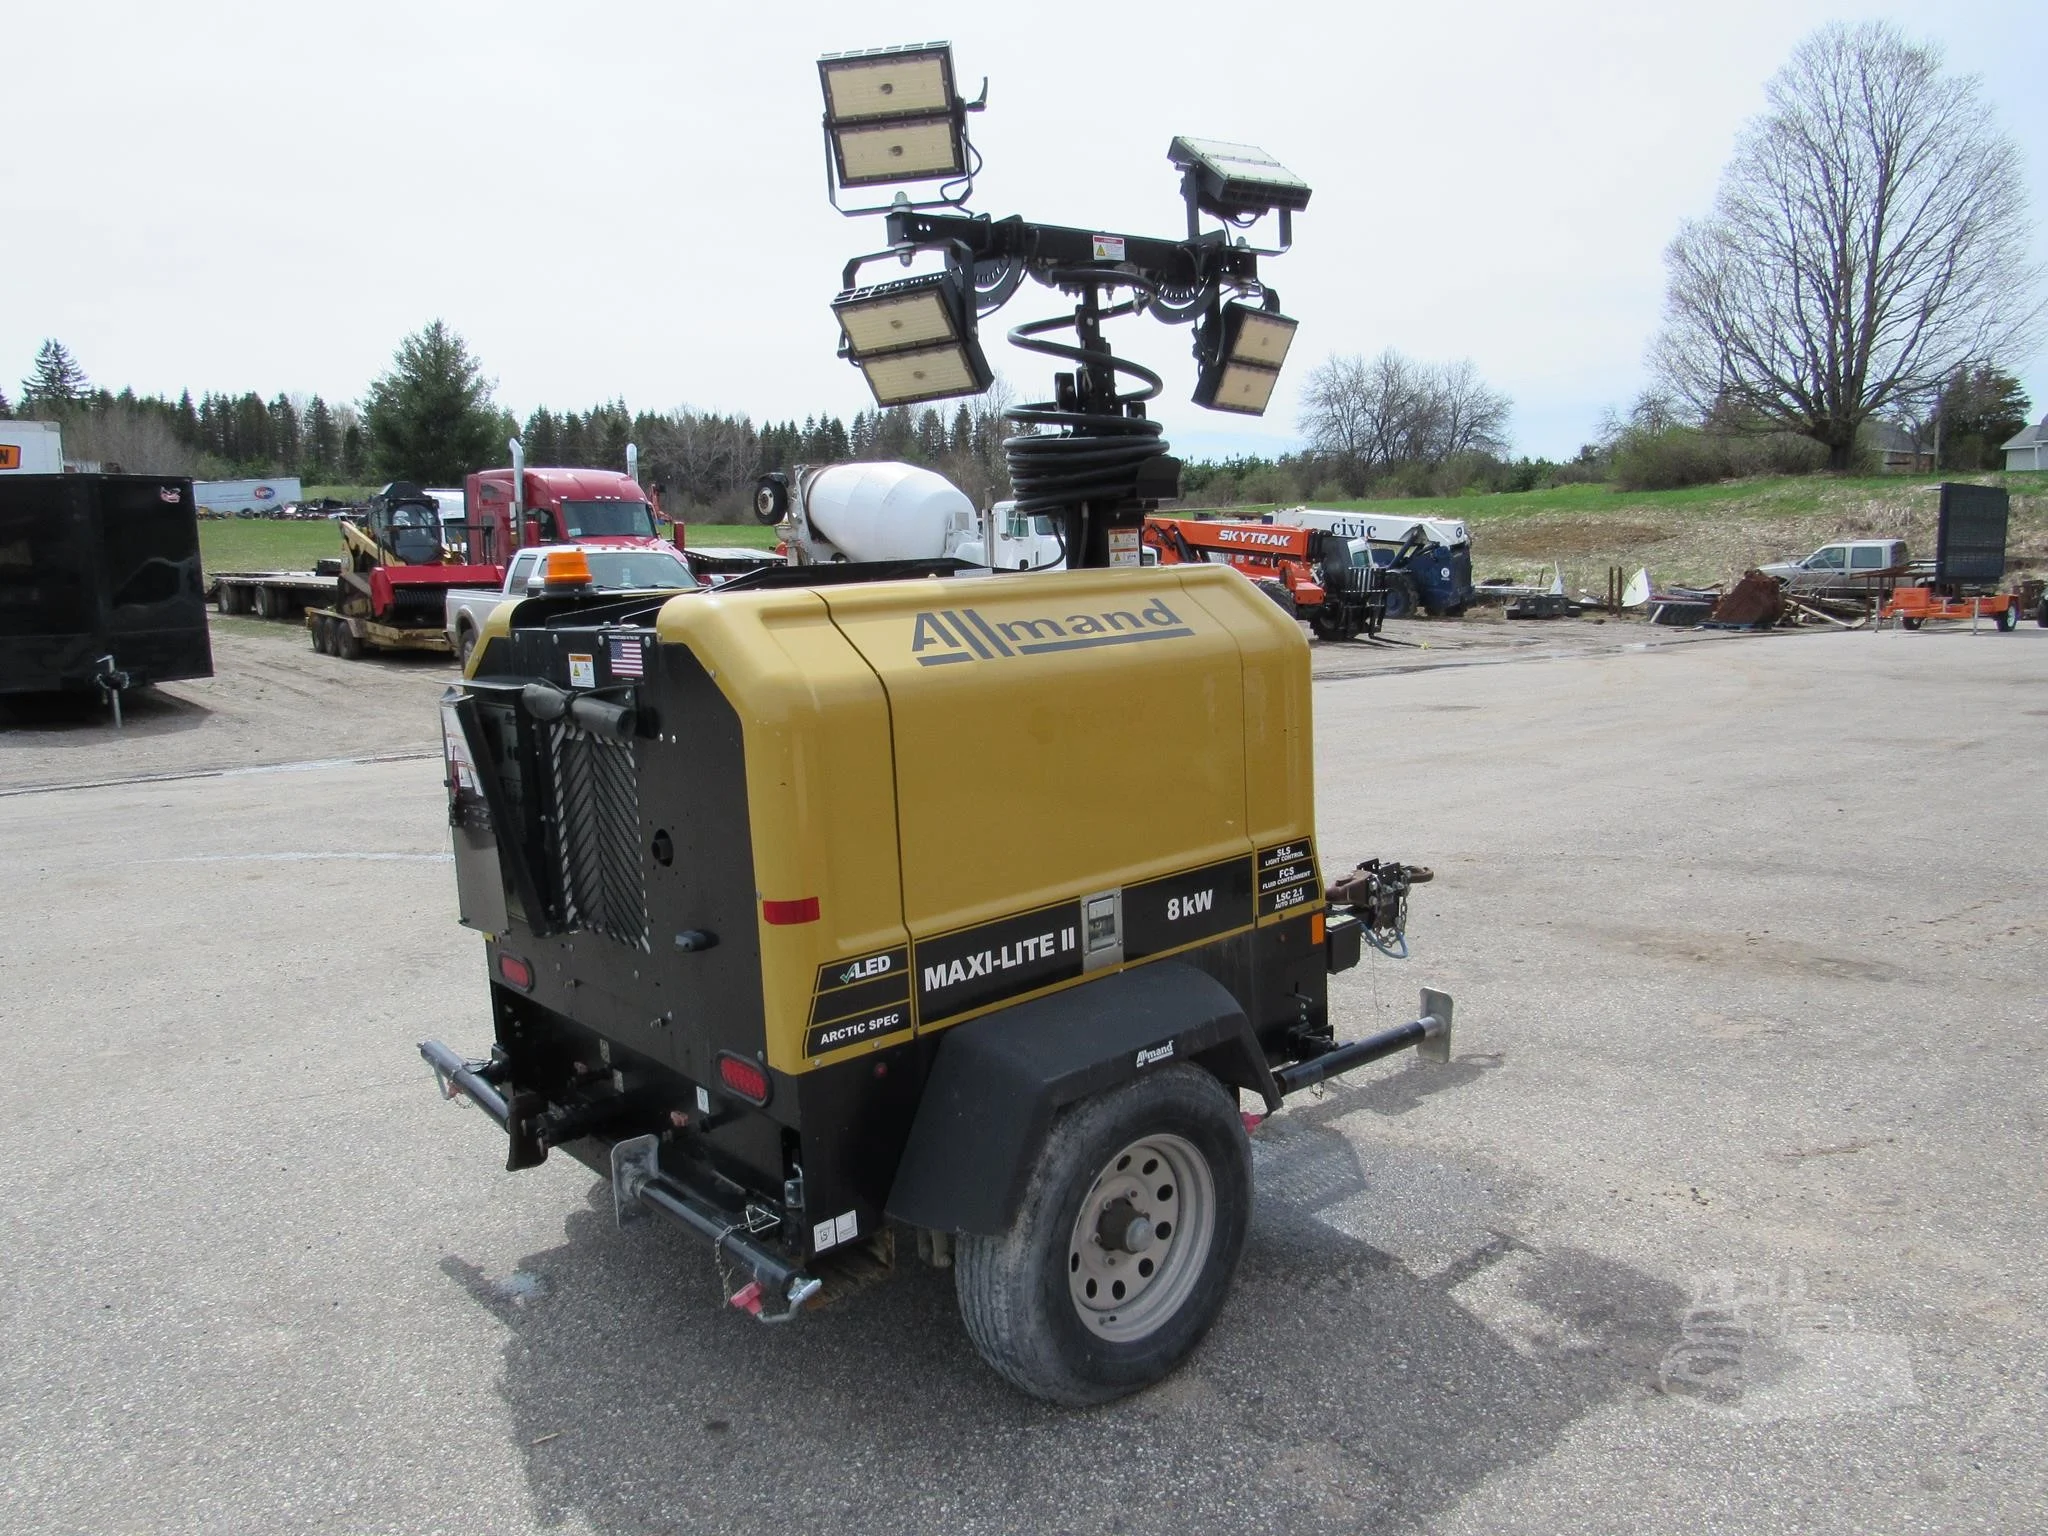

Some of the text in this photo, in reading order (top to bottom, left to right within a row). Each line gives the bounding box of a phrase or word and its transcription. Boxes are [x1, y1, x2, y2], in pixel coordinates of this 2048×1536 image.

[1218, 529, 1291, 547] SKYTRAK
[1331, 518, 1376, 539] civic
[911, 598, 1184, 661] Allmand
[1265, 851, 1304, 867] LIGHT CONTROL
[1276, 846, 1291, 857] SLS
[1262, 870, 1311, 890] FLUID CONTAINMENT
[1279, 866, 1295, 879] FCS
[1167, 888, 1214, 921] 8 kW
[1274, 895, 1305, 910] AUTO START
[1276, 887, 1303, 903] LSC 2.1
[854, 955, 891, 979] LED
[924, 926, 1075, 992] MAXI-LITE II
[820, 1013, 899, 1045] ARCTIC SPEC
